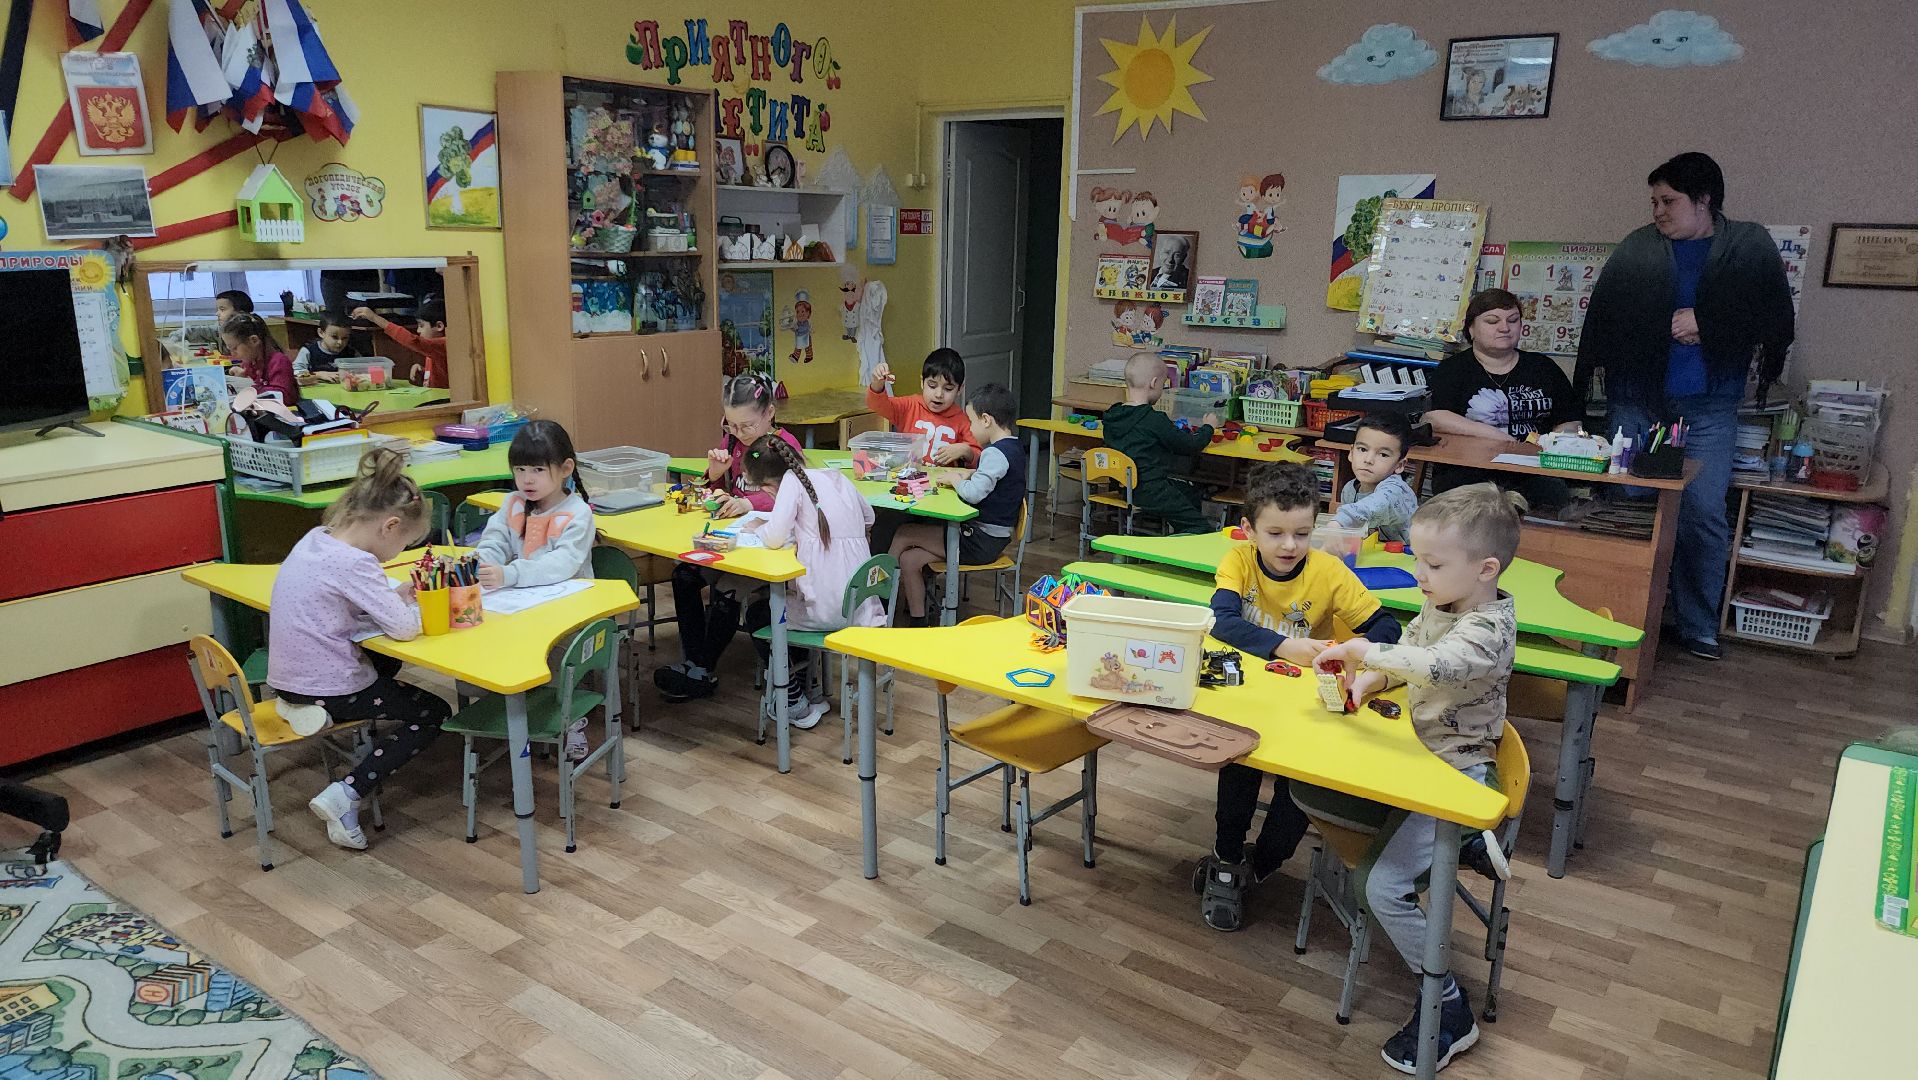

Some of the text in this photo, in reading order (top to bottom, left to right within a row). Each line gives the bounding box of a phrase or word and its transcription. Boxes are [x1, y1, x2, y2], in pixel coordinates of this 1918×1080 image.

[715, 88, 826, 153] ЕТИТА
[1562, 245, 1607, 254] ЦИФРЫ
[1511, 263, 1521, 277] 0
[1546, 264, 1555, 278] 1
[1583, 265, 1594, 279] 2
[1543, 295, 1553, 307] 5
[1579, 296, 1590, 309] 6
[1521, 324, 1531, 337] 8
[1556, 326, 1567, 339] 9
